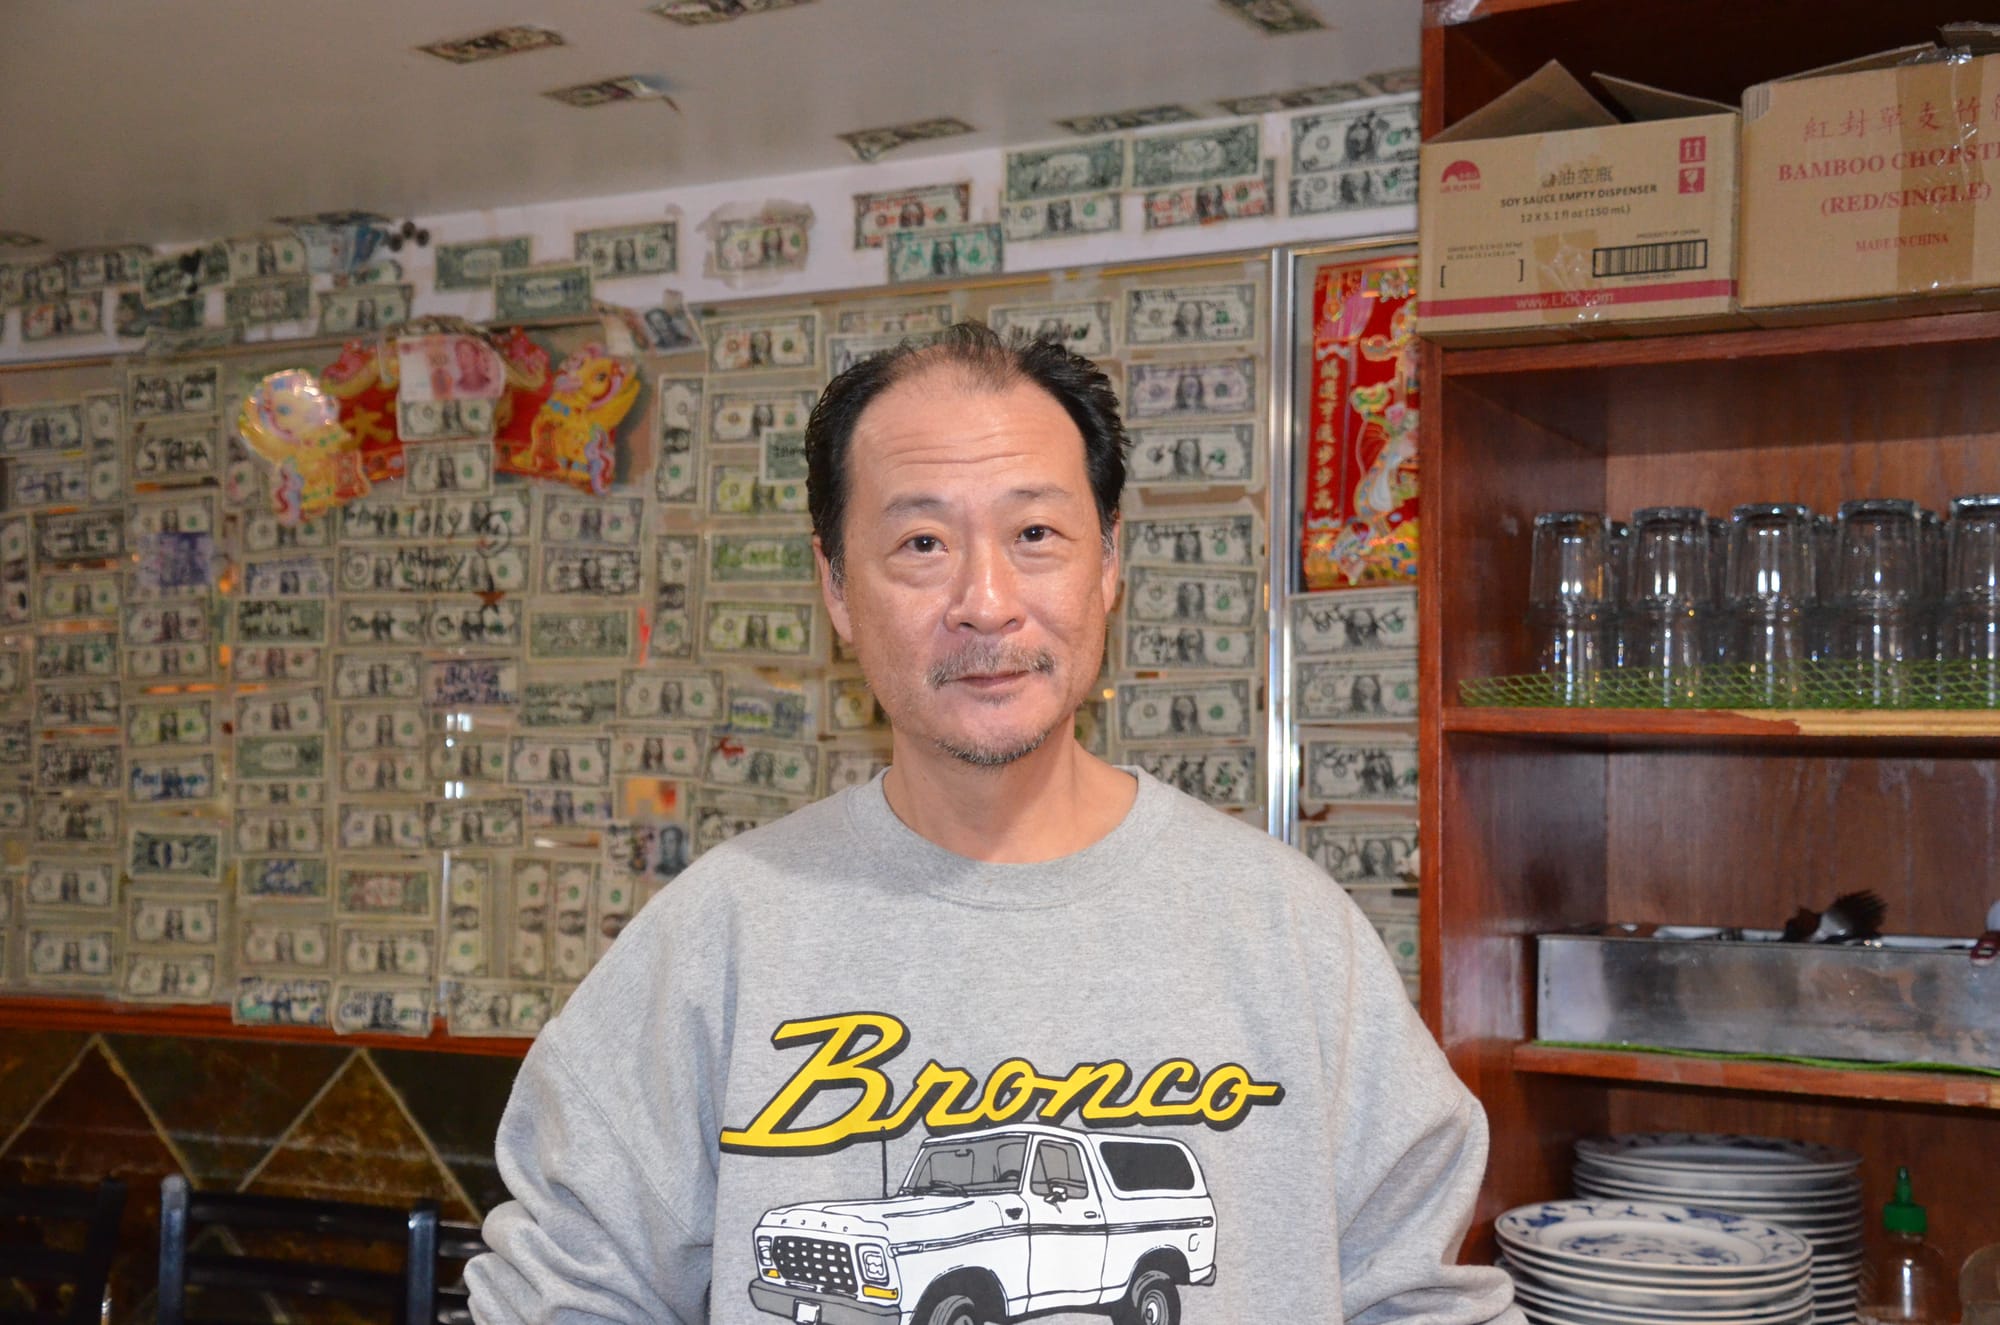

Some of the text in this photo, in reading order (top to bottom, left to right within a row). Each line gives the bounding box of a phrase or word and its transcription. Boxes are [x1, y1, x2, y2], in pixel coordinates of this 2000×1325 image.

[1778, 155, 1885, 181] BAMBOO
[1500, 184, 1657, 208] SOY SAUCE EMPTY DISPENSER
[1821, 182, 1991, 215] (RED/SINGLE)
[1521, 213, 1532, 223] 12
[1856, 232, 1948, 252] MADE IN CHINA
[720, 1012, 1285, 1156] Bronco
